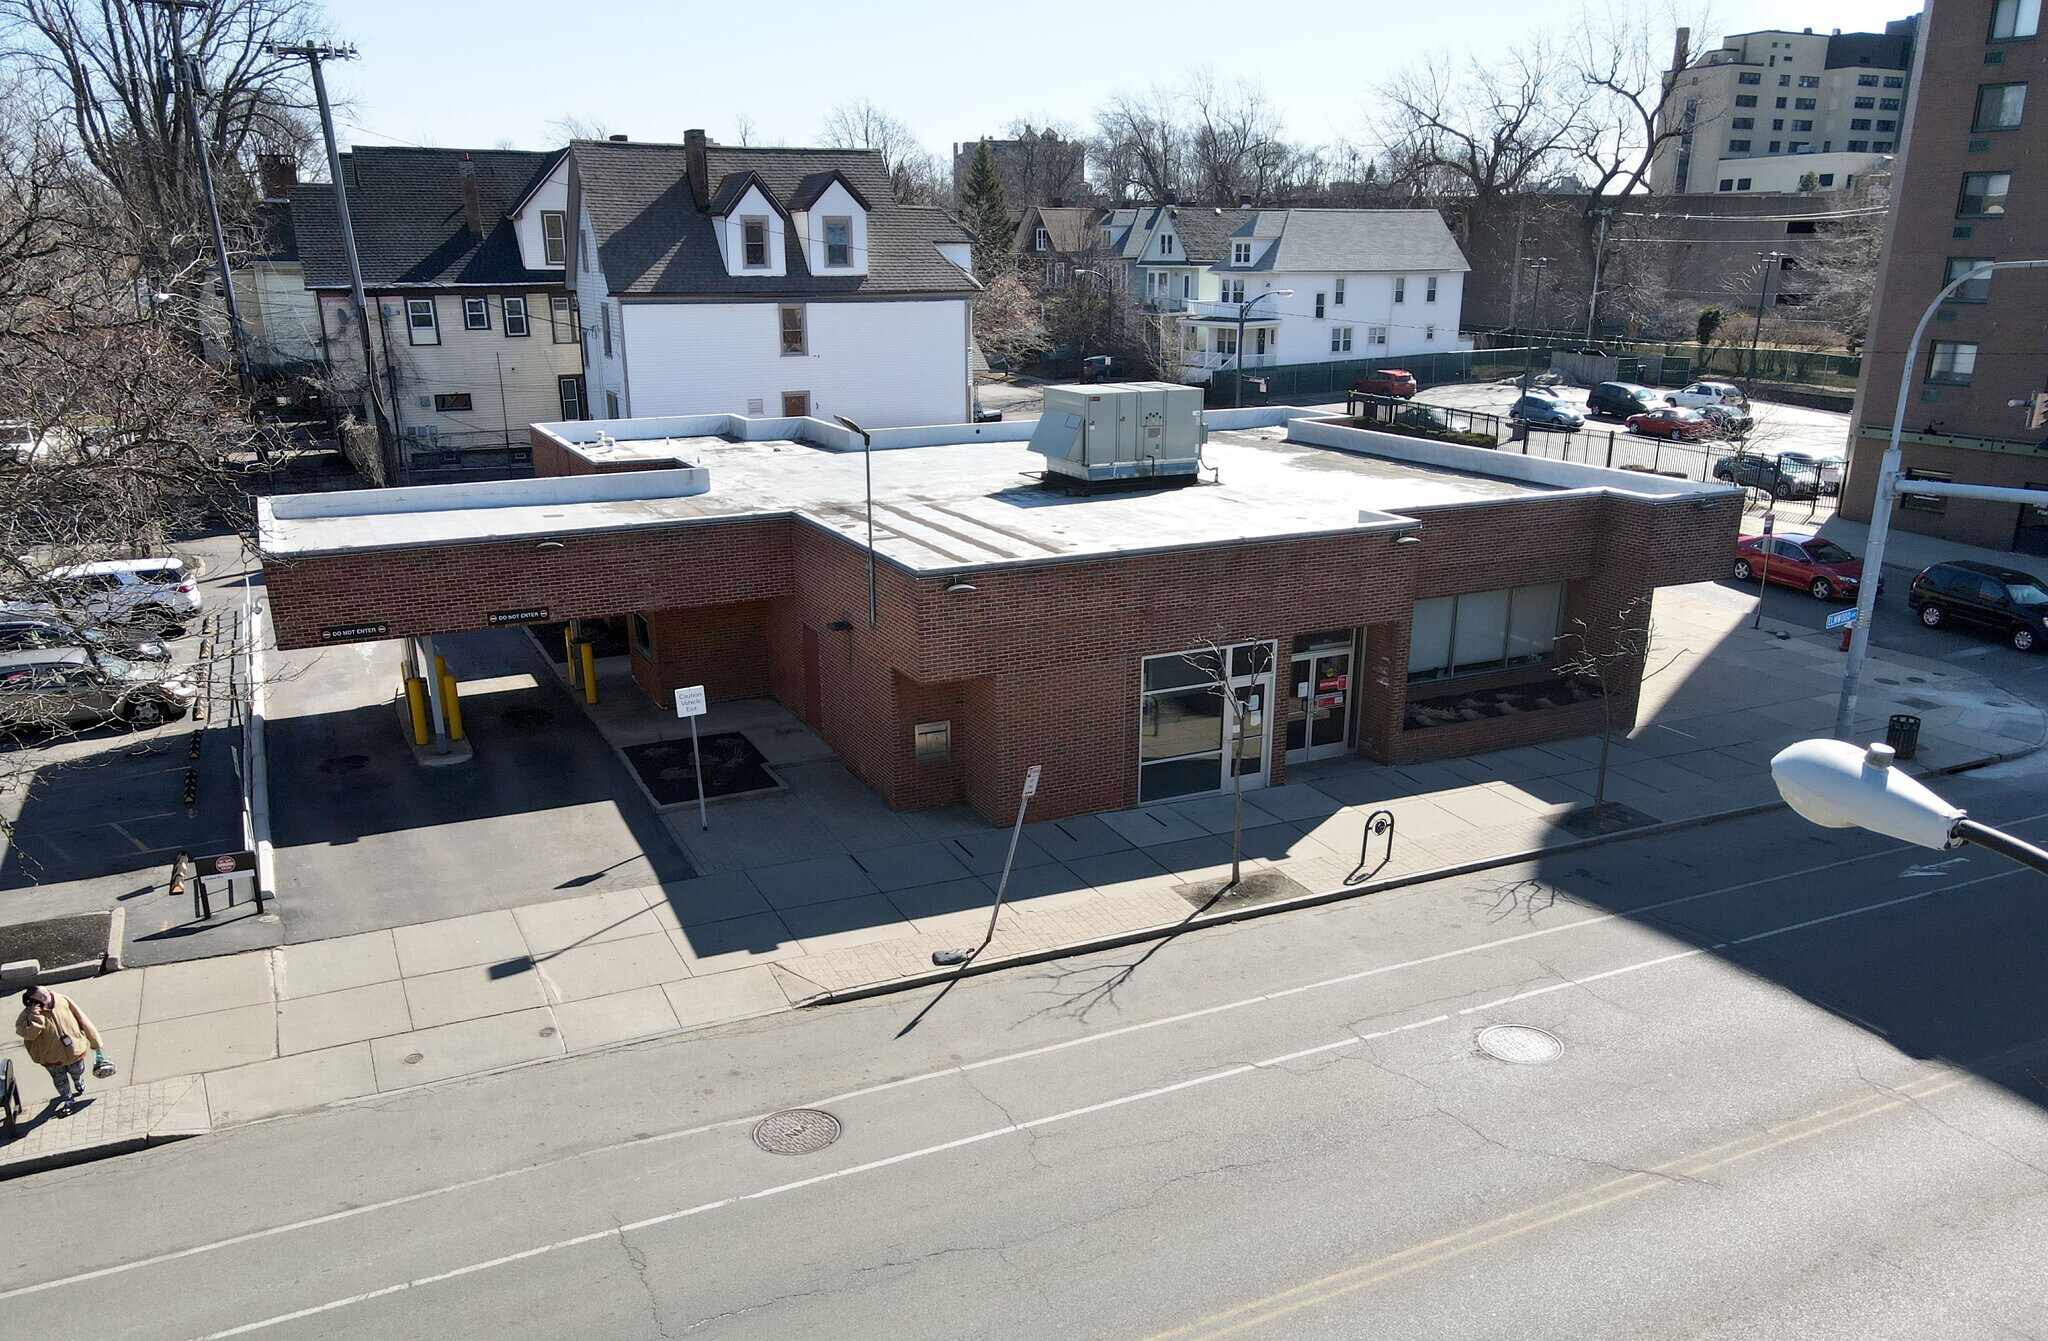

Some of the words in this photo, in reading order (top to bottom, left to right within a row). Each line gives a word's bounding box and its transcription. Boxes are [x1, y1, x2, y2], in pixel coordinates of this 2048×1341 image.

[1827, 612, 1851, 626] ELMWOOD
[679, 692, 702, 700] Caution
[680, 698, 701, 706] Vehicle
